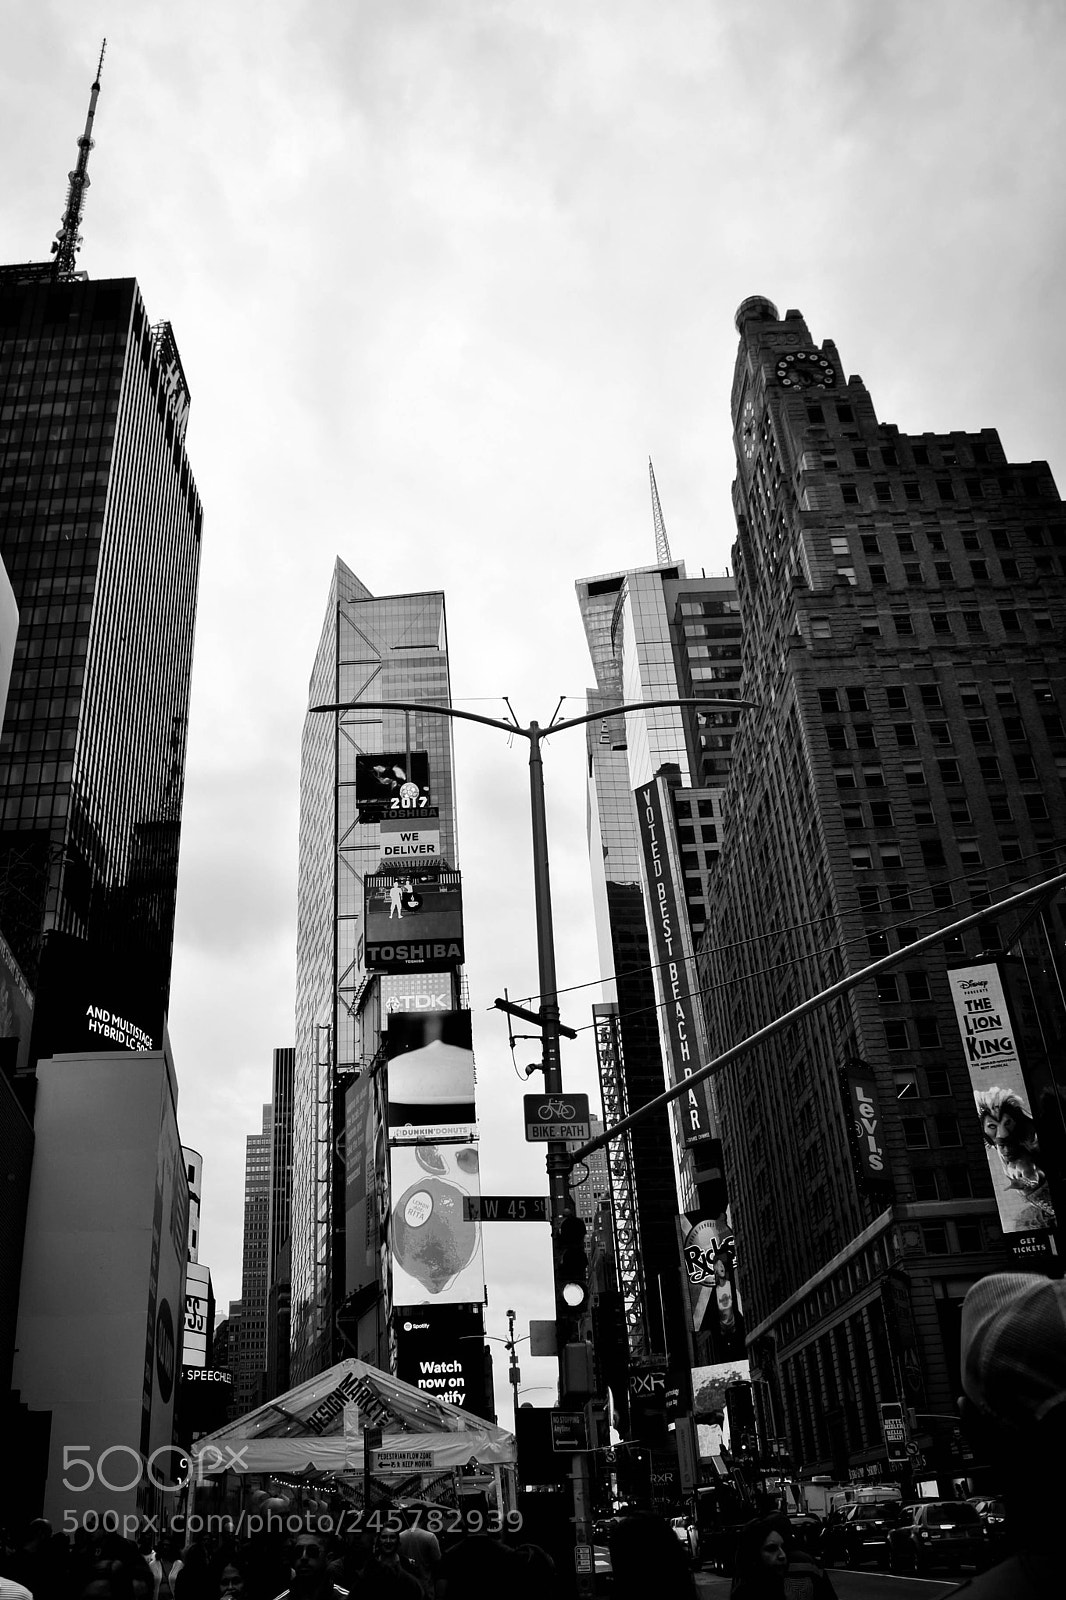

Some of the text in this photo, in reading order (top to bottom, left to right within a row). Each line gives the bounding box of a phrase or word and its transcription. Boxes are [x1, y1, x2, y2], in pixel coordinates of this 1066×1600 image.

[391, 797, 428, 809] 2017
[382, 809, 438, 819] TOSHIBA
[400, 833, 419, 842] WE
[385, 845, 436, 855] DELIVER
[643, 789, 662, 877] VOTED
[657, 882, 673, 956] BEST
[669, 962, 690, 1062] BEACH
[367, 944, 461, 961] TOSHIBA
[957, 980, 989, 989] Disney
[400, 994, 448, 1009] TDK
[964, 998, 993, 1012] THE
[86, 1004, 153, 1050] AND MULTISTAGE
[89, 1019, 148, 1052] HYBRID LC 50
[532, 1125, 585, 1138] BIKE PATH
[484, 1199, 499, 1219] W
[507, 1200, 527, 1219] 45
[1019, 1237, 1036, 1245] GET
[1012, 1244, 1047, 1254] TICKETS
[419, 1360, 462, 1374] Watch
[418, 1377, 465, 1389] now on
[338, 1372, 388, 1422] MARKET
[436, 1390, 466, 1406] otify
[305, 1387, 350, 1435] DESIGN
[377, 1452, 406, 1460] PEDESTRIAN
[407, 1452, 419, 1460] FLOW
[415, 1460, 432, 1468] MOVING
